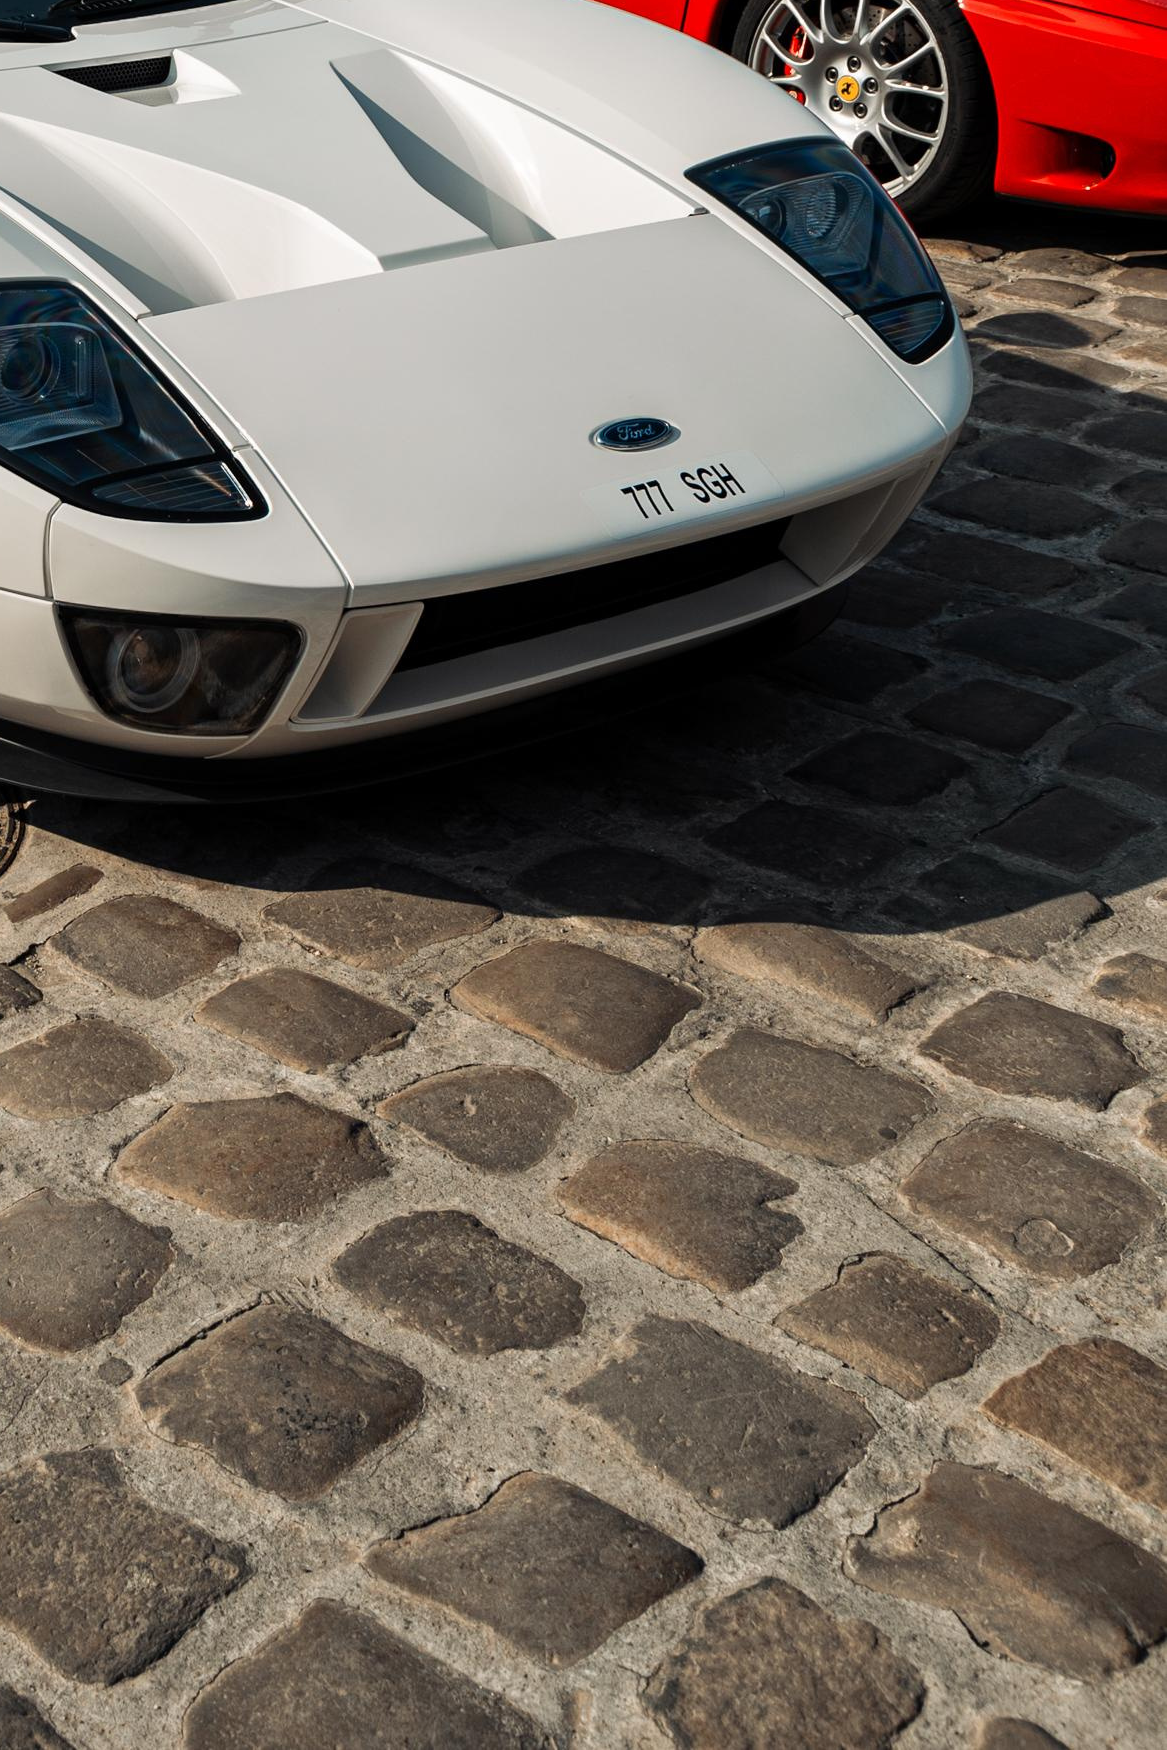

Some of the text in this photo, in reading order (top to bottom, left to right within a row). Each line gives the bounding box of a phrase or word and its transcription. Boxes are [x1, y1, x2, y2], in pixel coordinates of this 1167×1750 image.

[616, 423, 656, 442] Ford
[620, 463, 745, 519] 777 SGH
